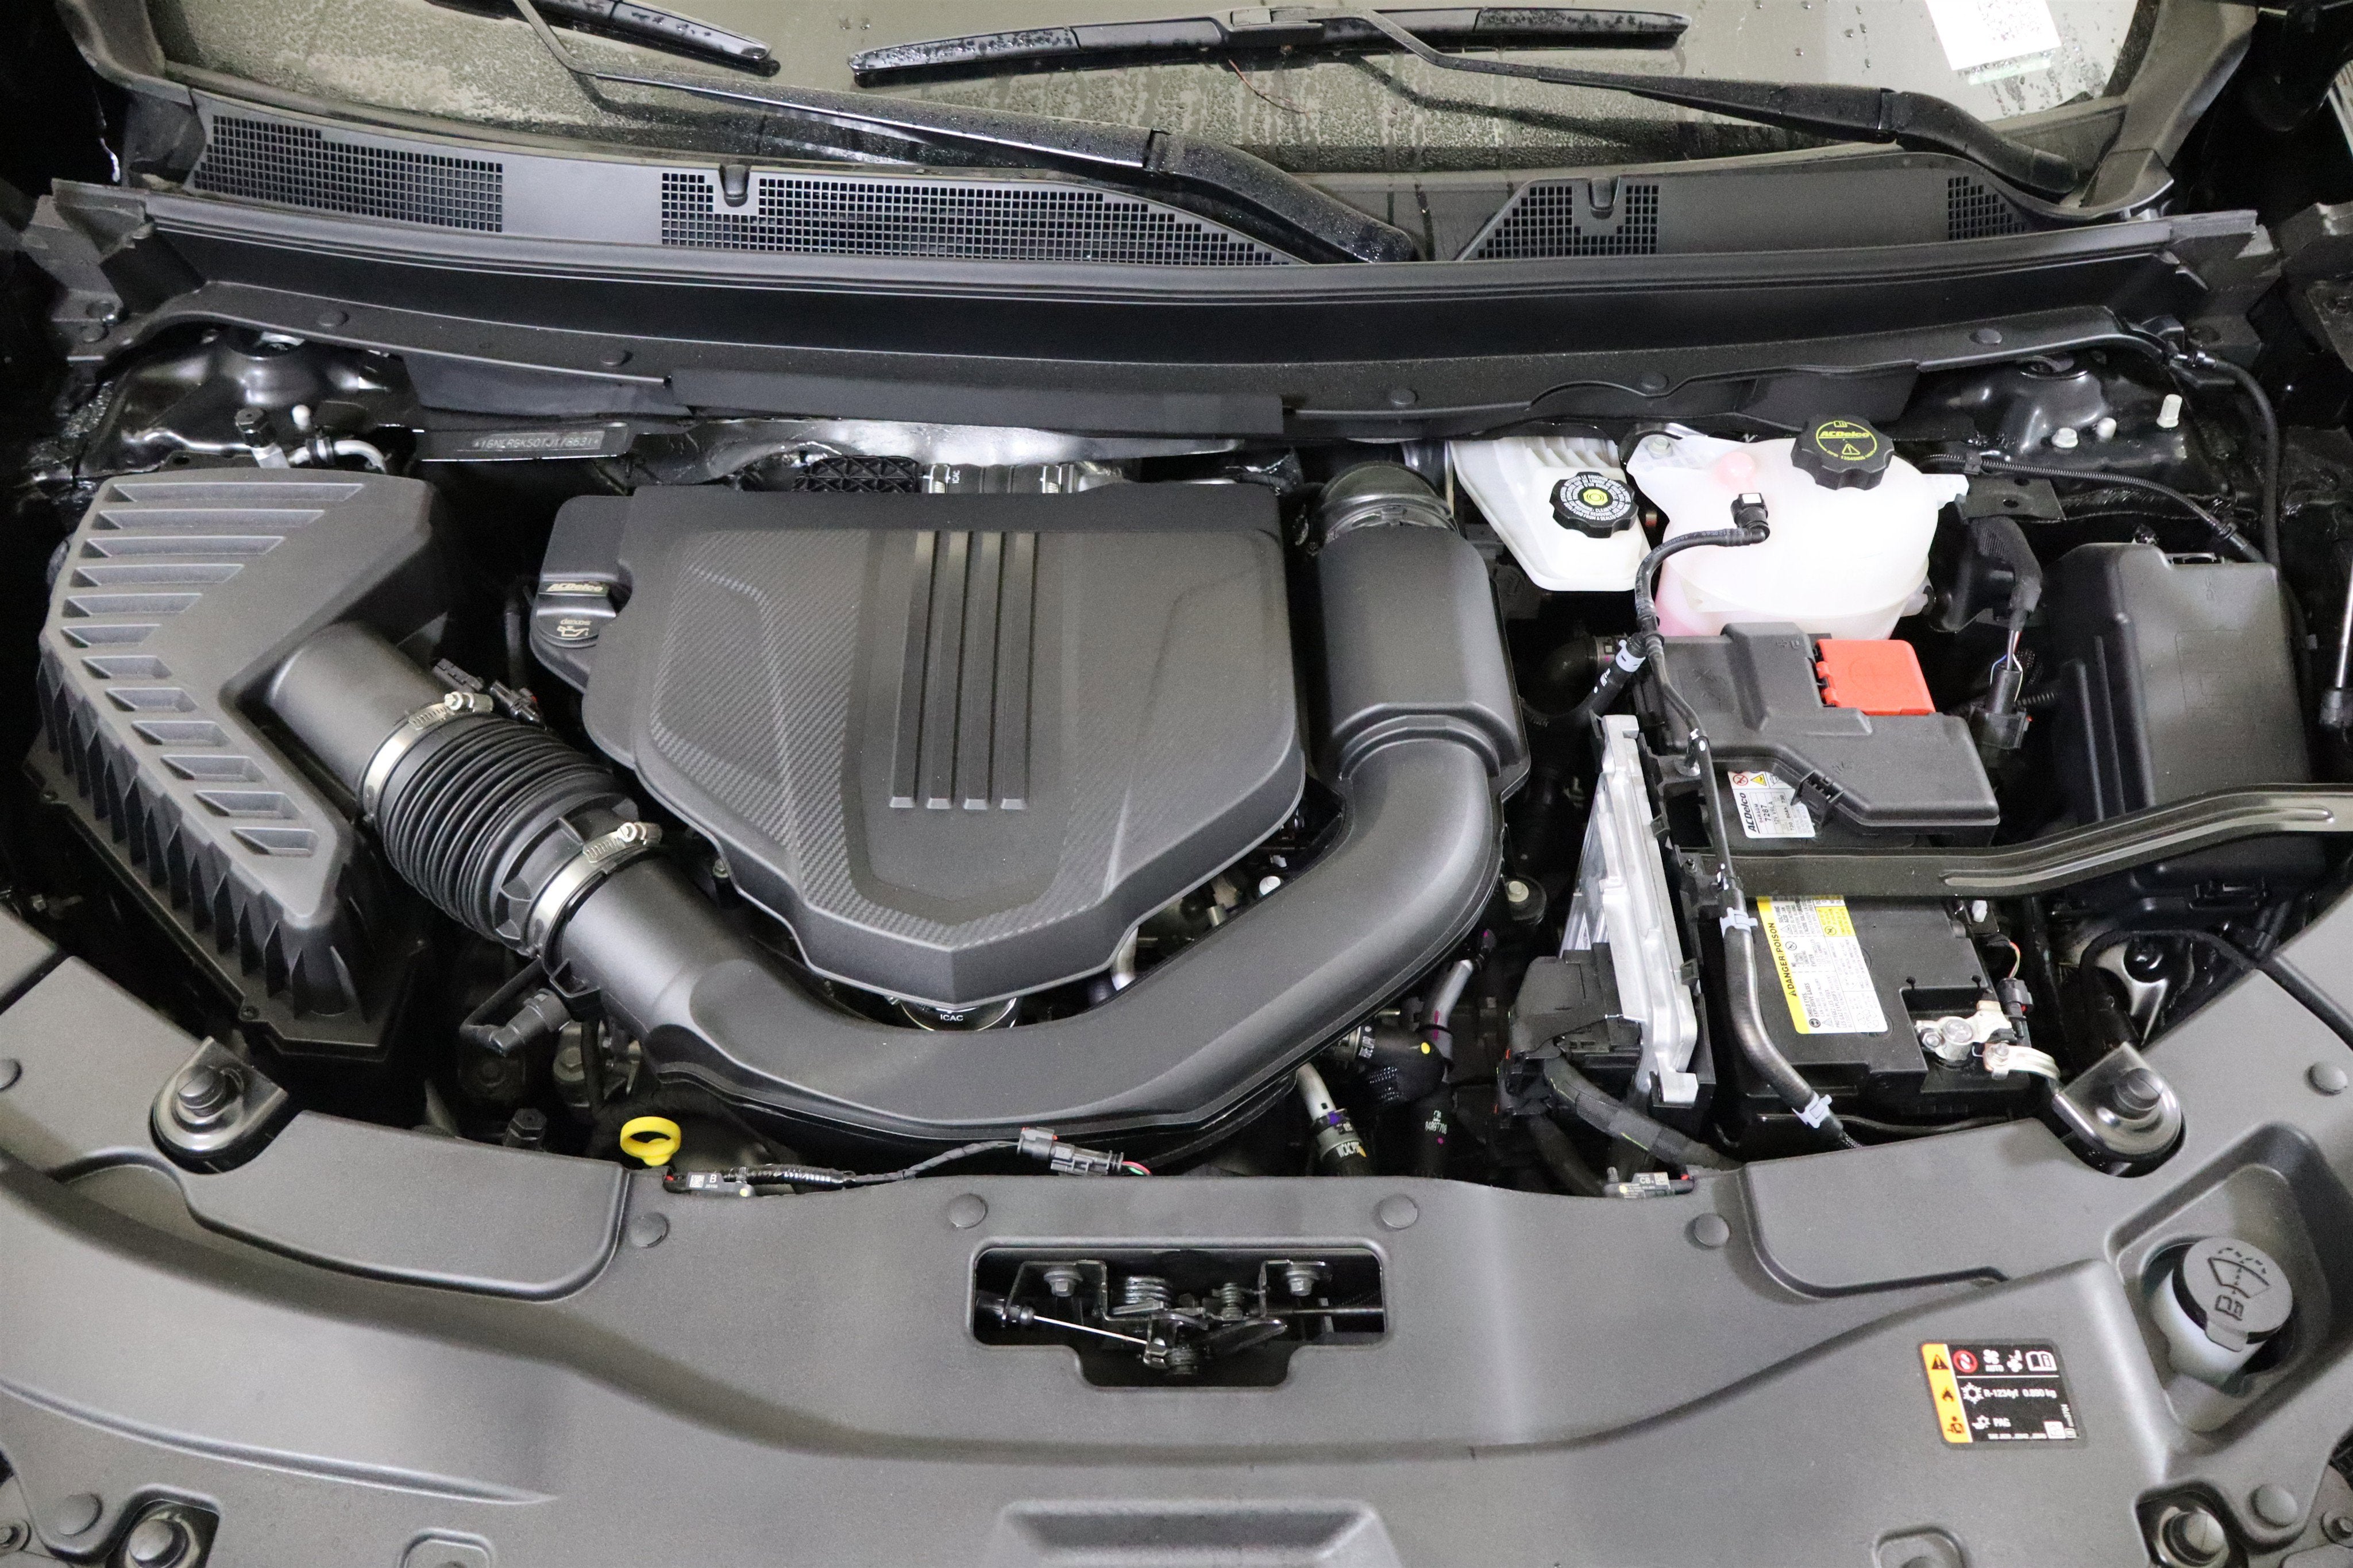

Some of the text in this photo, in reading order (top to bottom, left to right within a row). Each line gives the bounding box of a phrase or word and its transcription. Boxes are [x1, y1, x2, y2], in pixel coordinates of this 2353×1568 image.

[546, 583, 603, 592] ACDelco
[1739, 793, 1756, 832] ACDelco
[1761, 805, 1771, 821] 7287
[1768, 923, 1794, 988] DANGER/POISON
[709, 1174, 717, 1183] B
[1984, 1389, 2019, 1399] R-1234yf
[2045, 1389, 2058, 1399] kg
[1993, 1418, 2011, 1427] PAG
